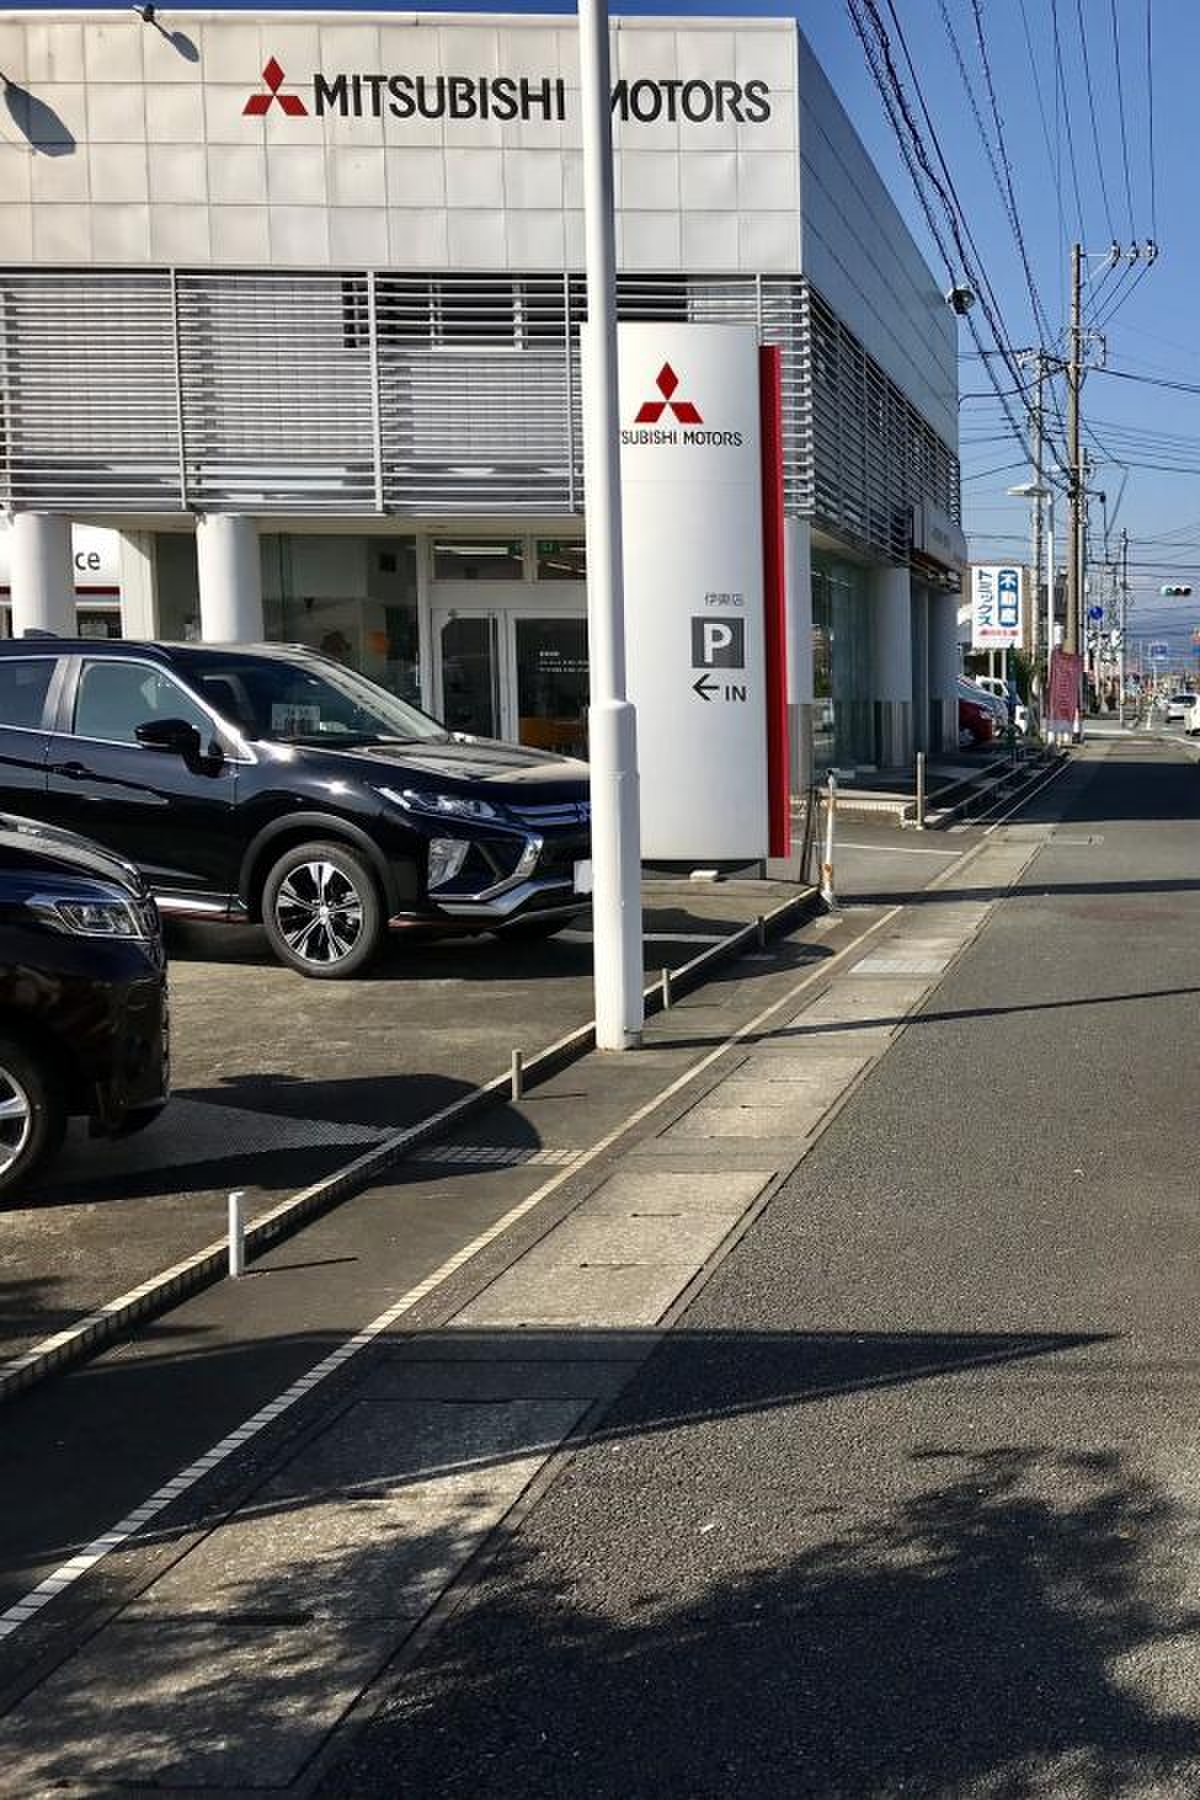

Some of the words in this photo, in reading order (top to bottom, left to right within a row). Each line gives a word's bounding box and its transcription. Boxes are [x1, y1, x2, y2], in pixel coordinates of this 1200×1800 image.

[314, 73, 566, 121] MITSUBISHI
[621, 430, 678, 446] SUBISHI
[683, 431, 743, 447] MOTORS
[703, 623, 733, 664] P
[725, 685, 747, 703] IN
